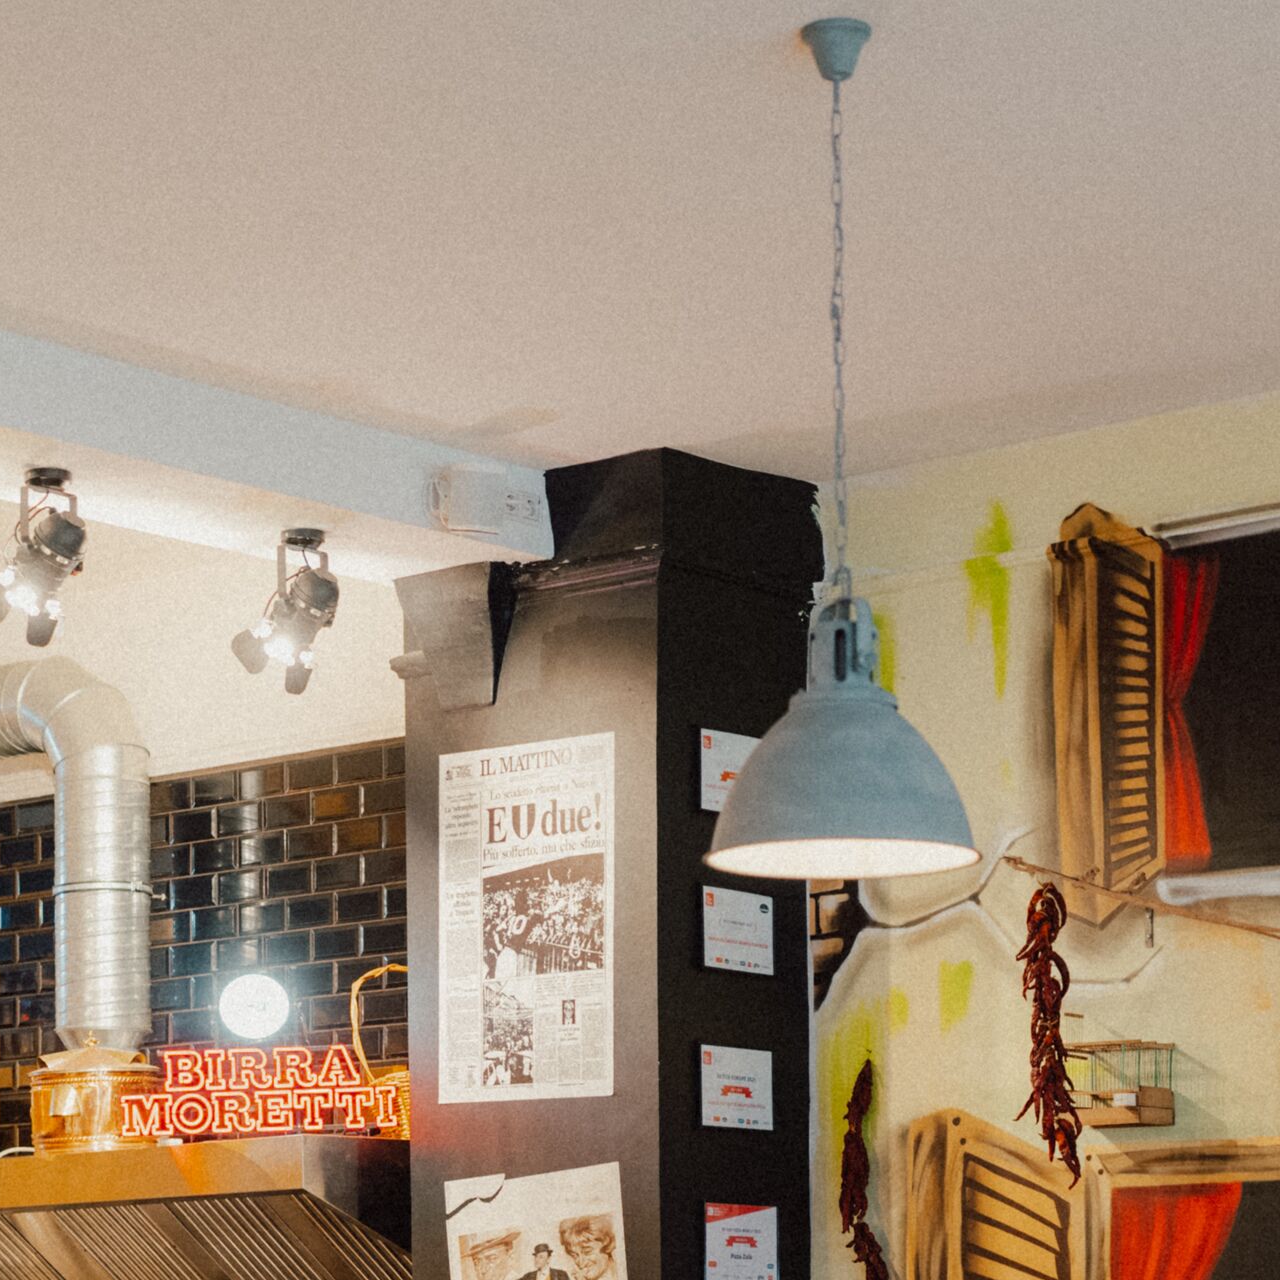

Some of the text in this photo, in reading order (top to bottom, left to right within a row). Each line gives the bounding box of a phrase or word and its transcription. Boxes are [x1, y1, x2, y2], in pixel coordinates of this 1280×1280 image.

[480, 759, 496, 777] IL
[499, 748, 573, 775] MATTINO
[487, 806, 507, 844] E
[541, 792, 602, 837] due!
[164, 1045, 360, 1091] BIRRA
[121, 1085, 399, 1138] MORETTI
